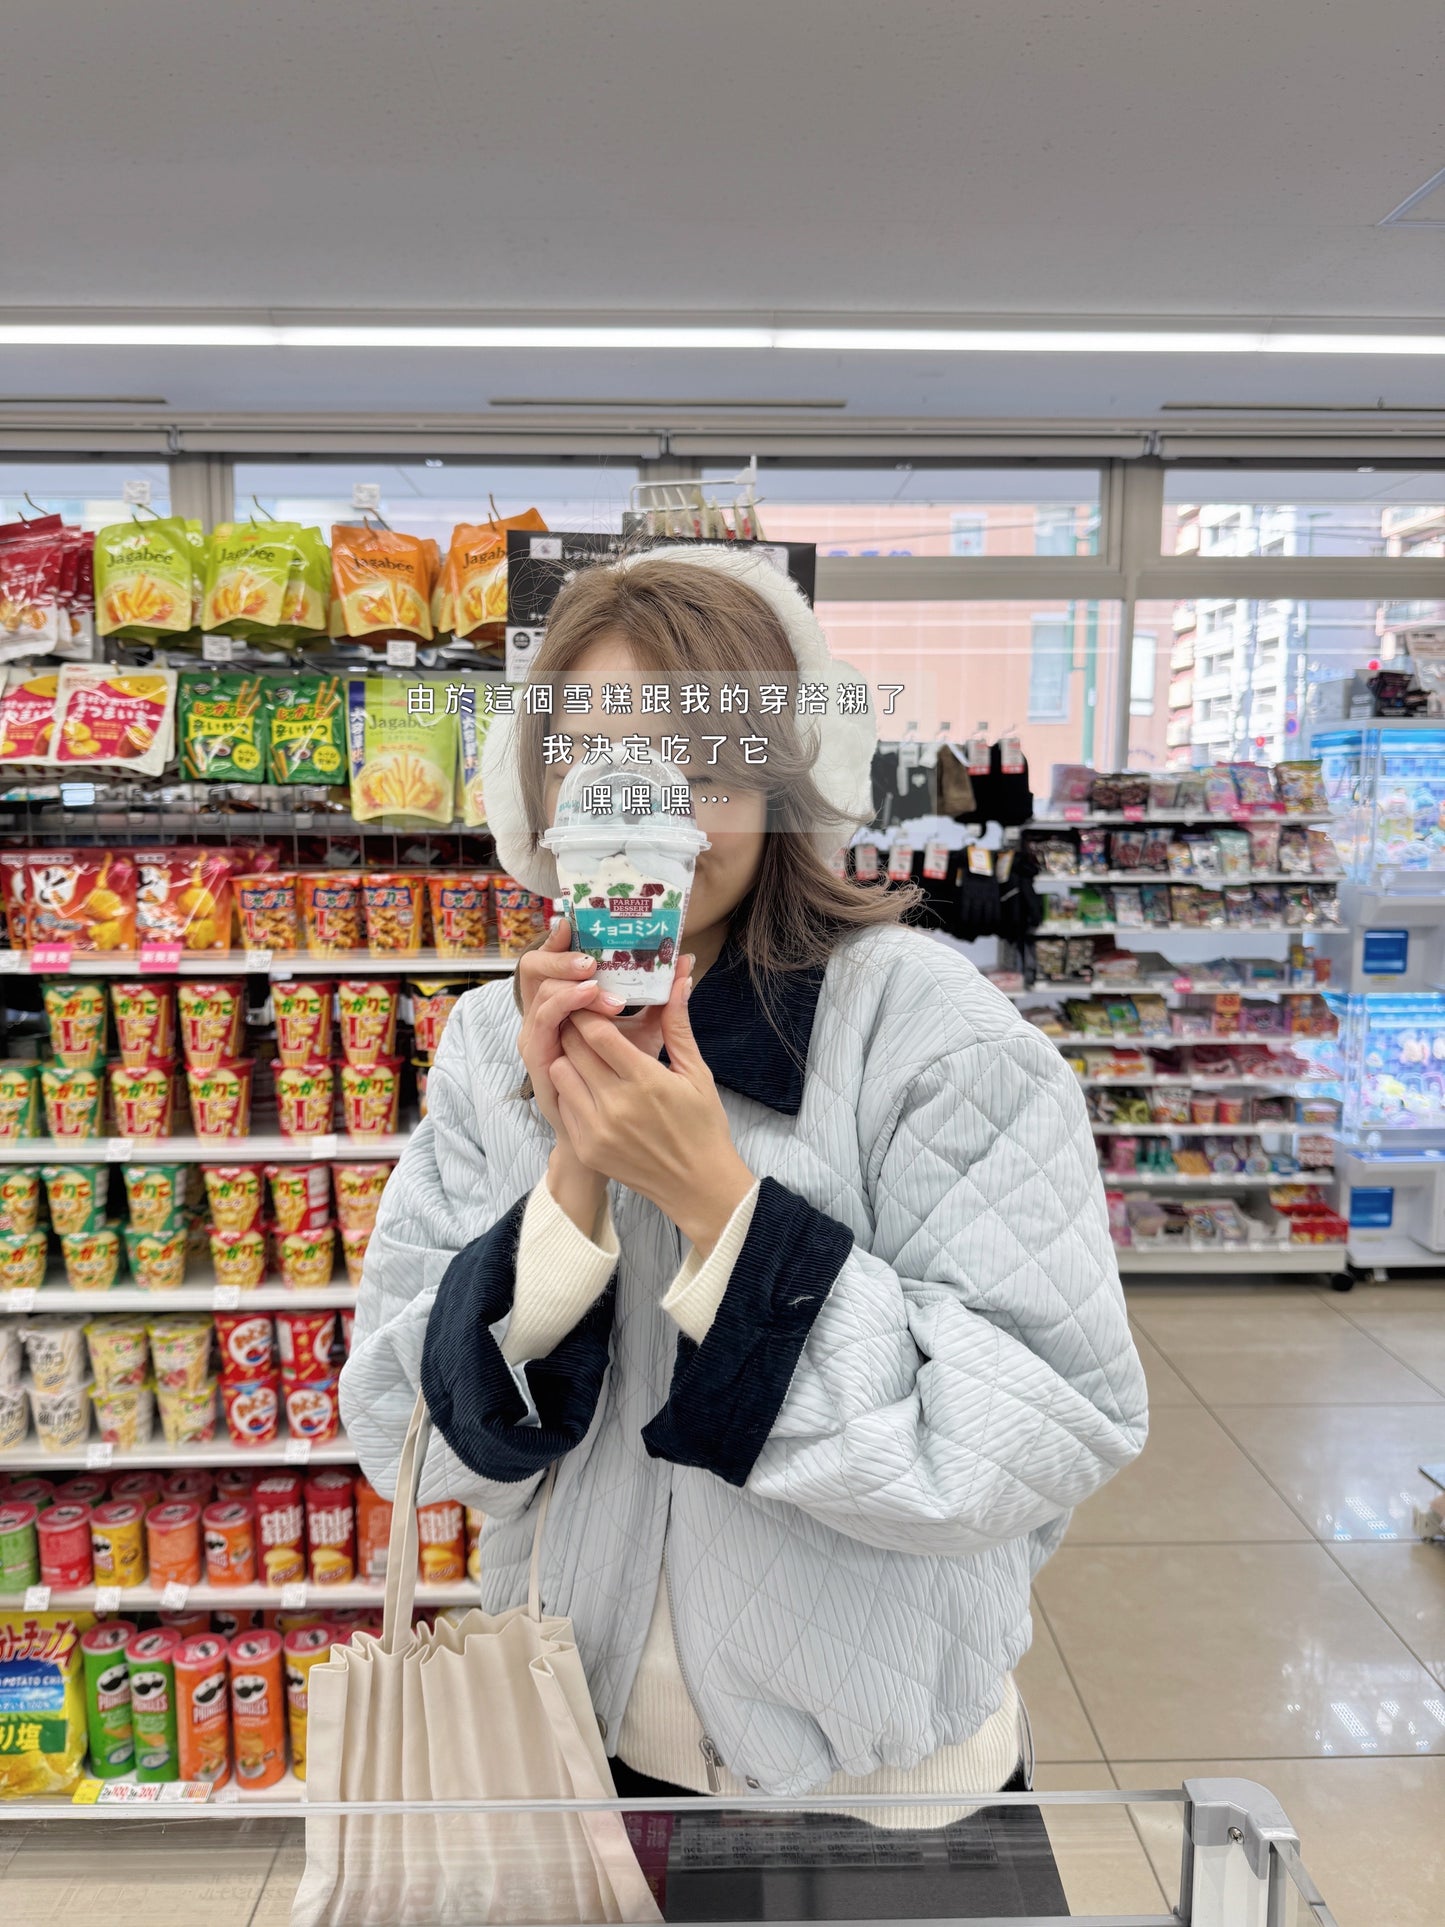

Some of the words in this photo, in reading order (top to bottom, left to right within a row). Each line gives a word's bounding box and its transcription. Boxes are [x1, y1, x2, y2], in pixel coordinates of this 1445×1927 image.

[107, 548, 173, 567] Jagabee
[463, 547, 507, 569] Jagab
[589, 920, 669, 937] チョコミント
[2, 1676, 41, 1687] POTATO
[0, 1723, 42, 1751] り塩
